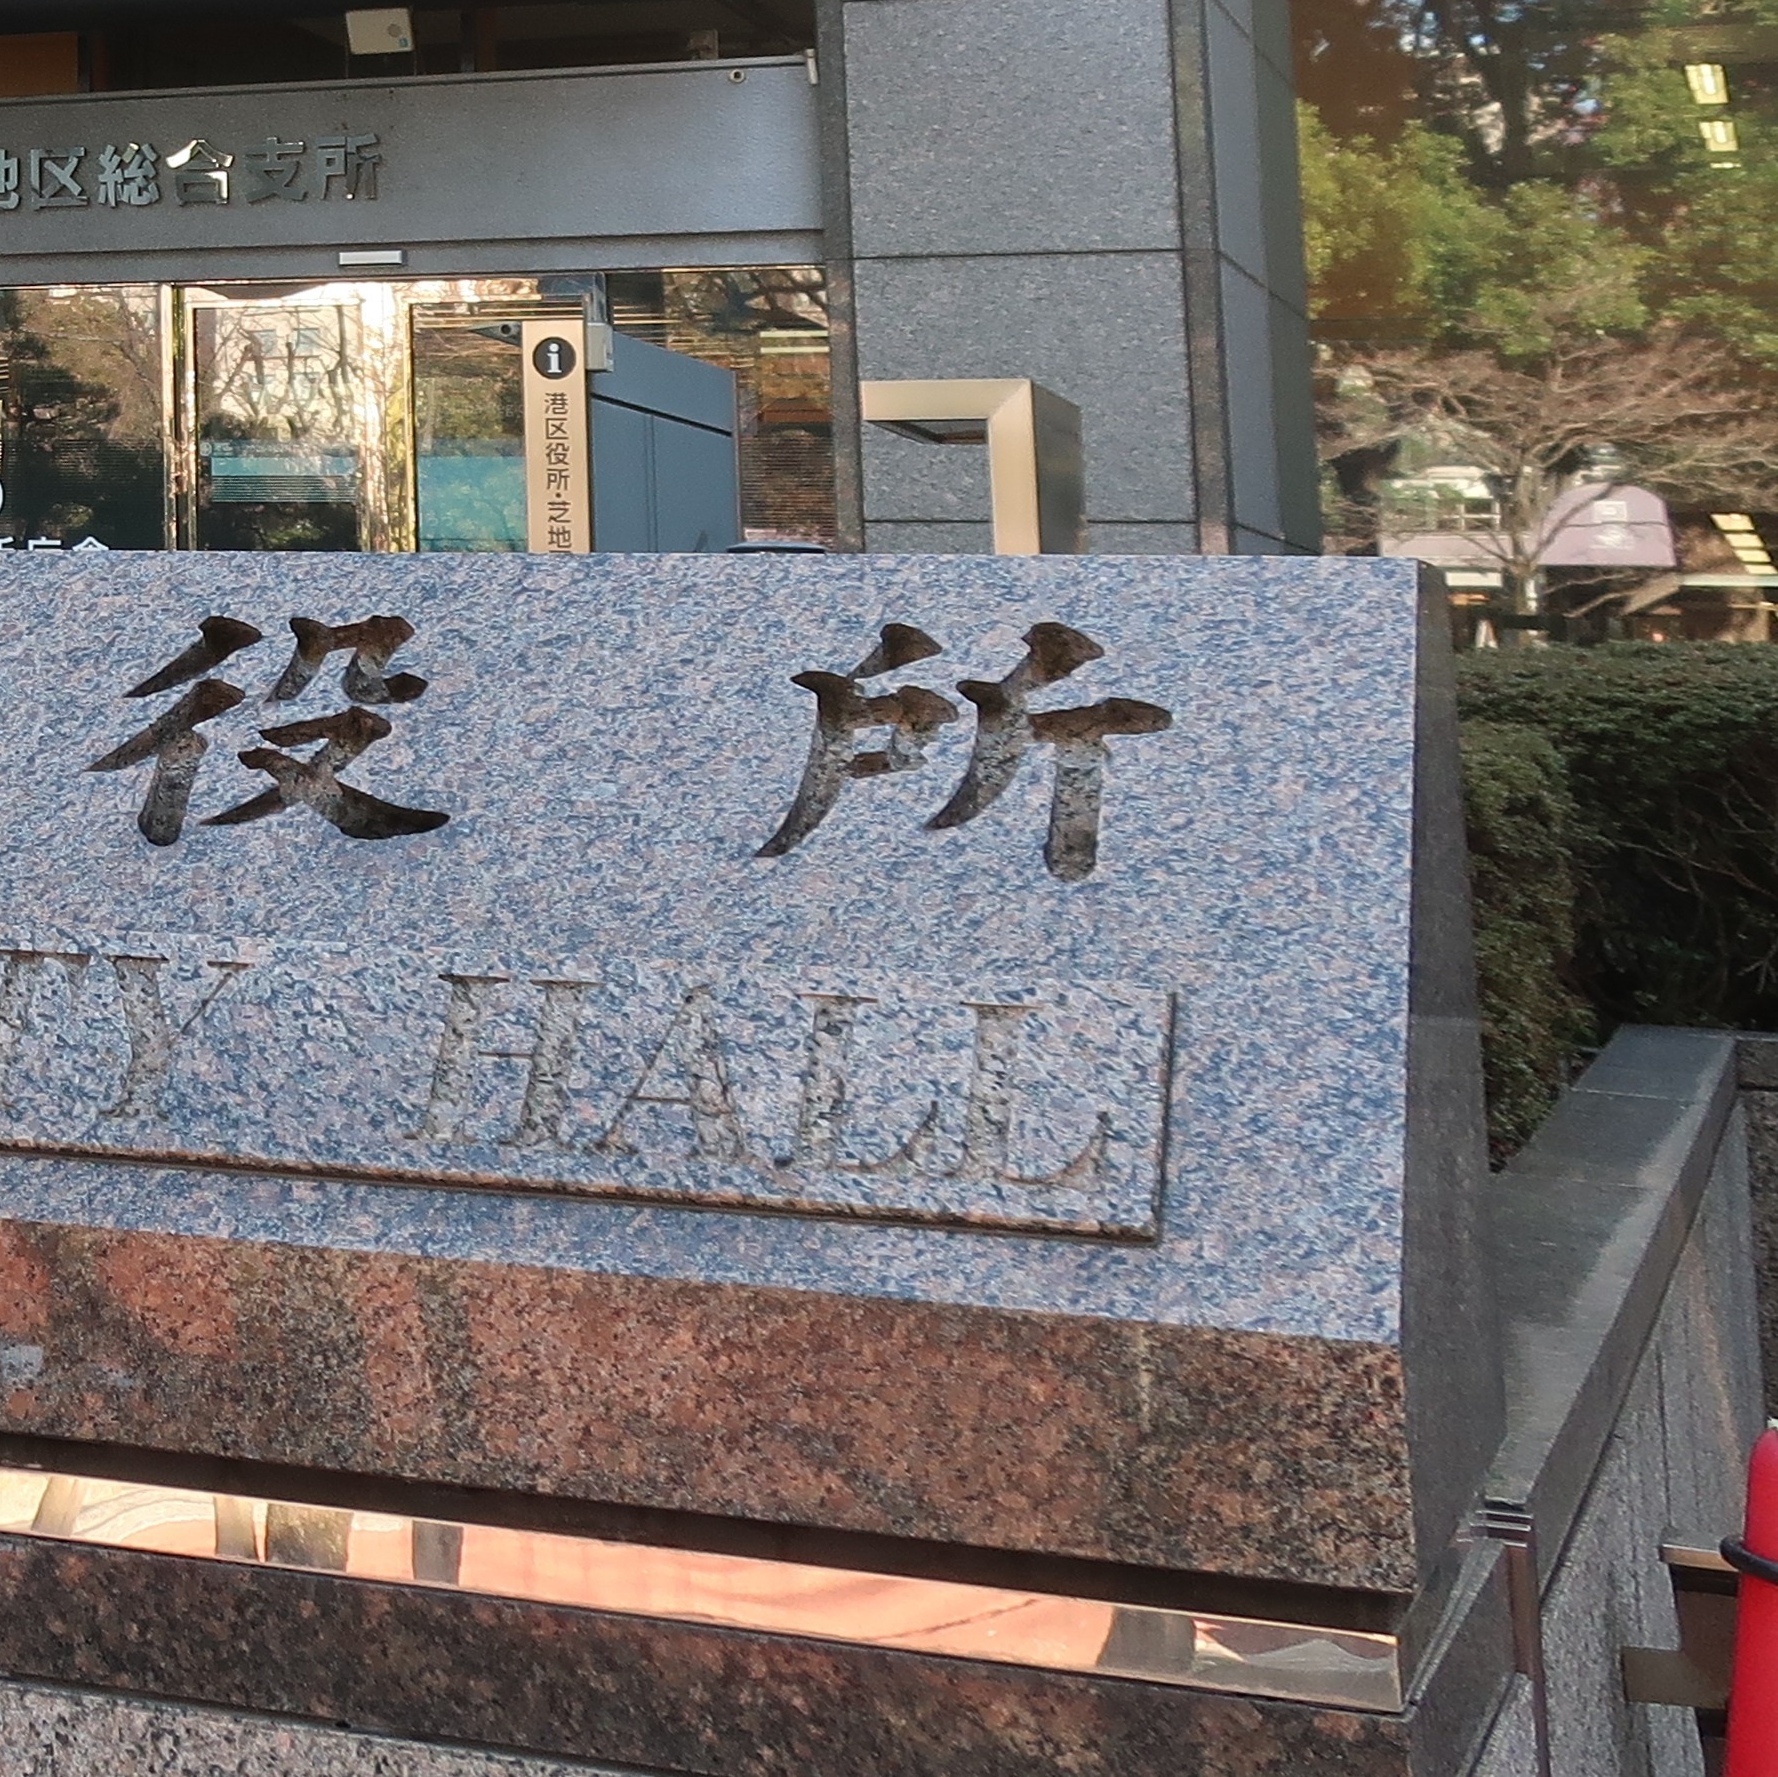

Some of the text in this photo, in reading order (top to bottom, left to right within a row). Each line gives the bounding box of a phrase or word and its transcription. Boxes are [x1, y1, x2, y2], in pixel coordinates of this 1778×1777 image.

[544, 392, 573, 553] 港区役所・芝地
[405, 972, 1113, 1186] HALL
